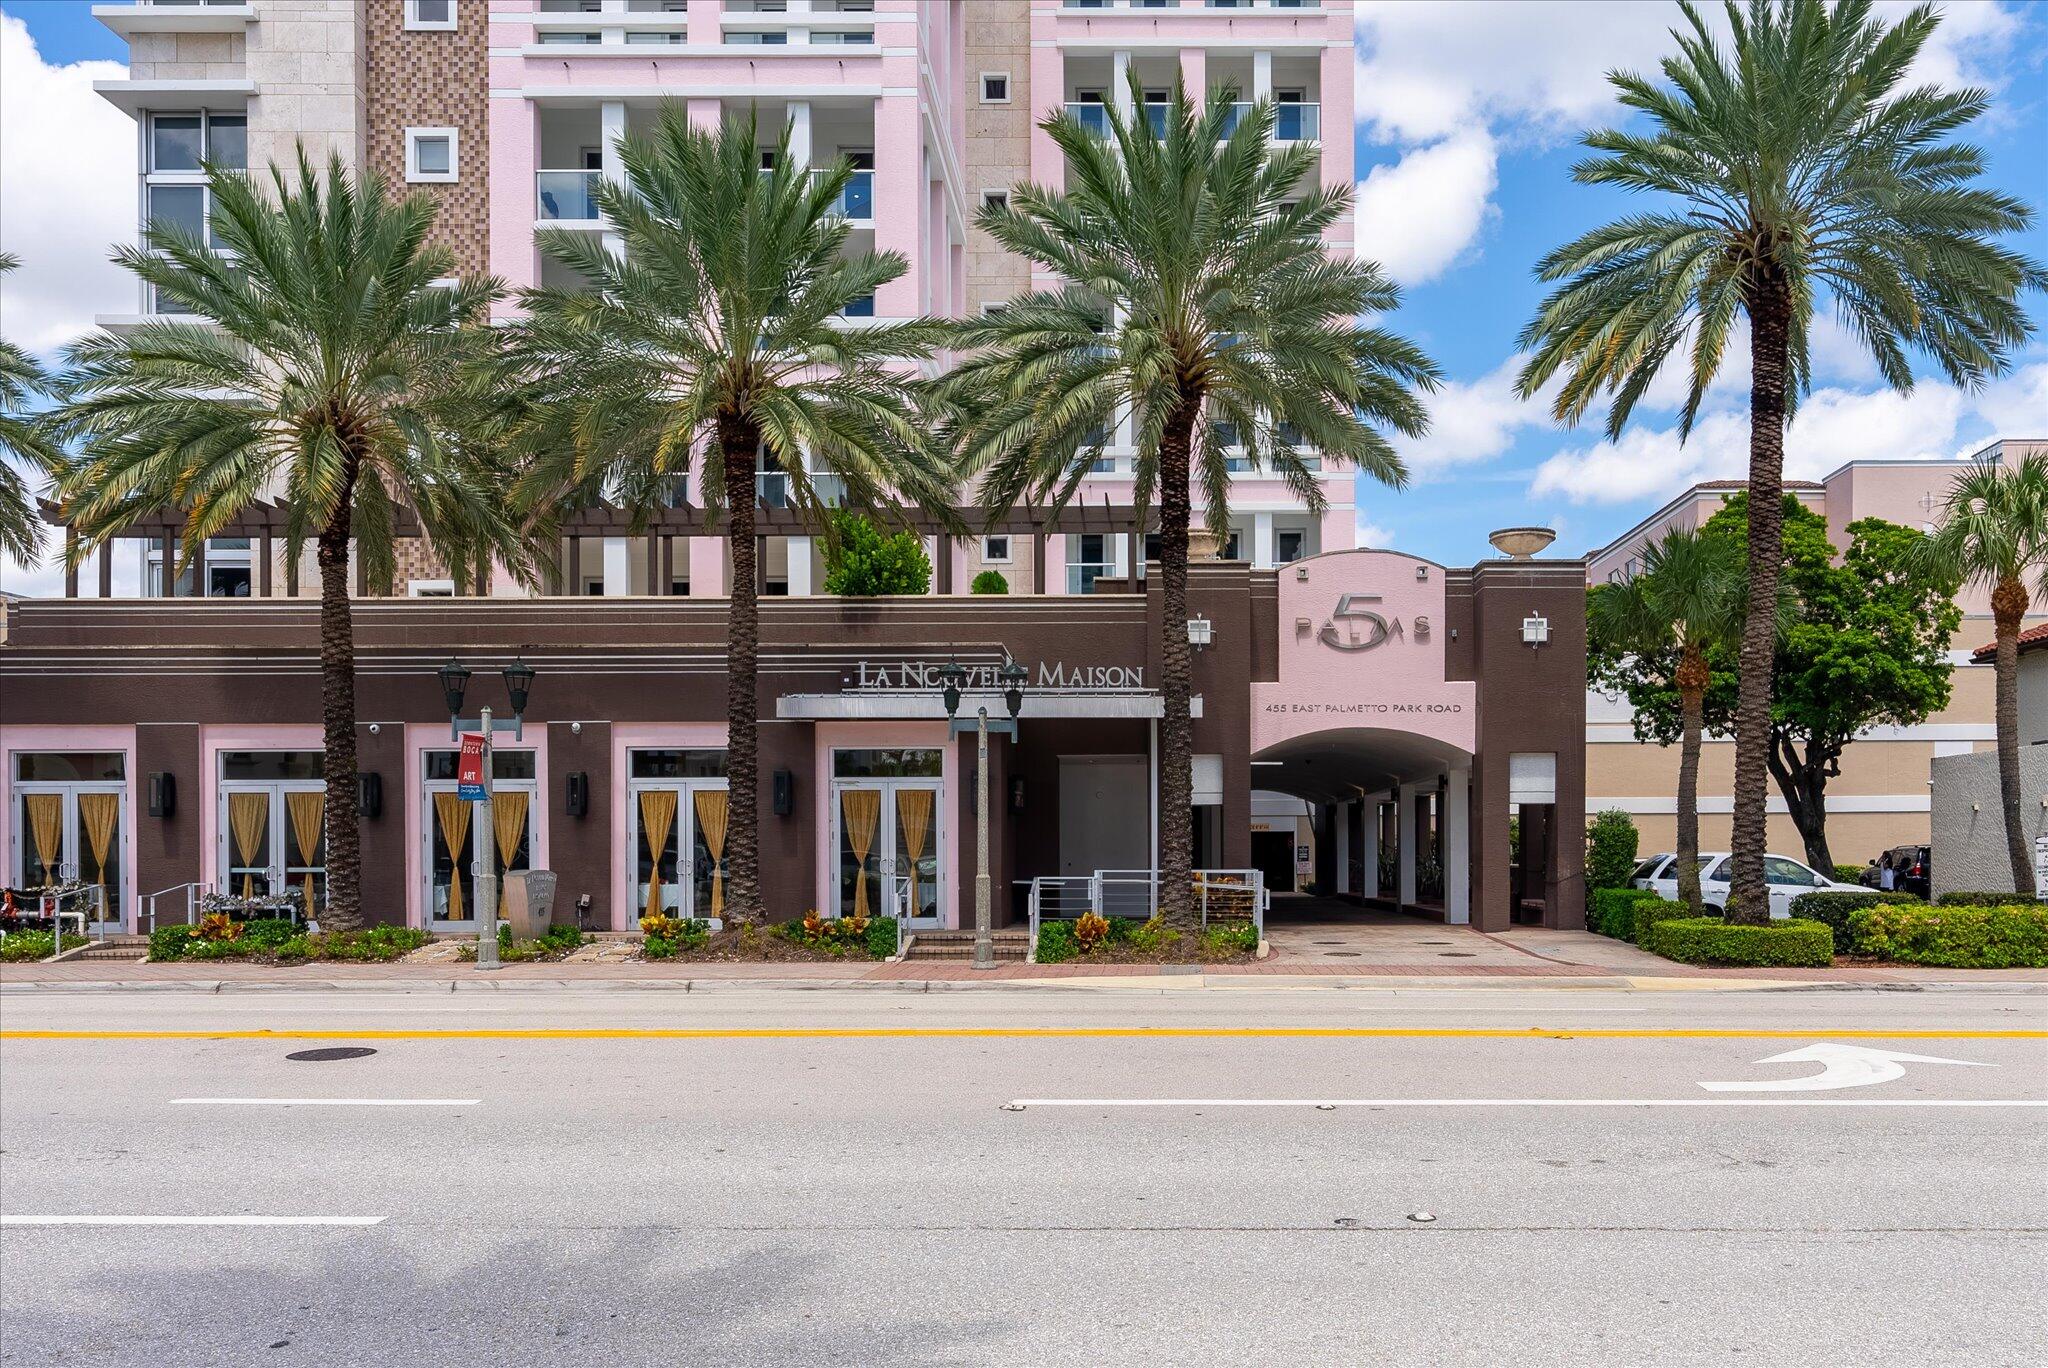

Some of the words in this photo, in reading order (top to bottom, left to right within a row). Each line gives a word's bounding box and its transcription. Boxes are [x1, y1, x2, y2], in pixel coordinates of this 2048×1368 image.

[1295, 615, 1431, 635] PALMS
[1321, 592, 1388, 649] 5
[858, 661, 892, 686] LA
[1036, 661, 1144, 686] MAISON
[1265, 704, 1287, 713] 455
[1292, 704, 1321, 713] EAST
[1325, 704, 1388, 713] PALMETTO
[1392, 704, 1422, 713] PARK
[1426, 704, 1462, 713] ROAD
[463, 745, 480, 755] BOCA
[463, 771, 476, 781] ART
